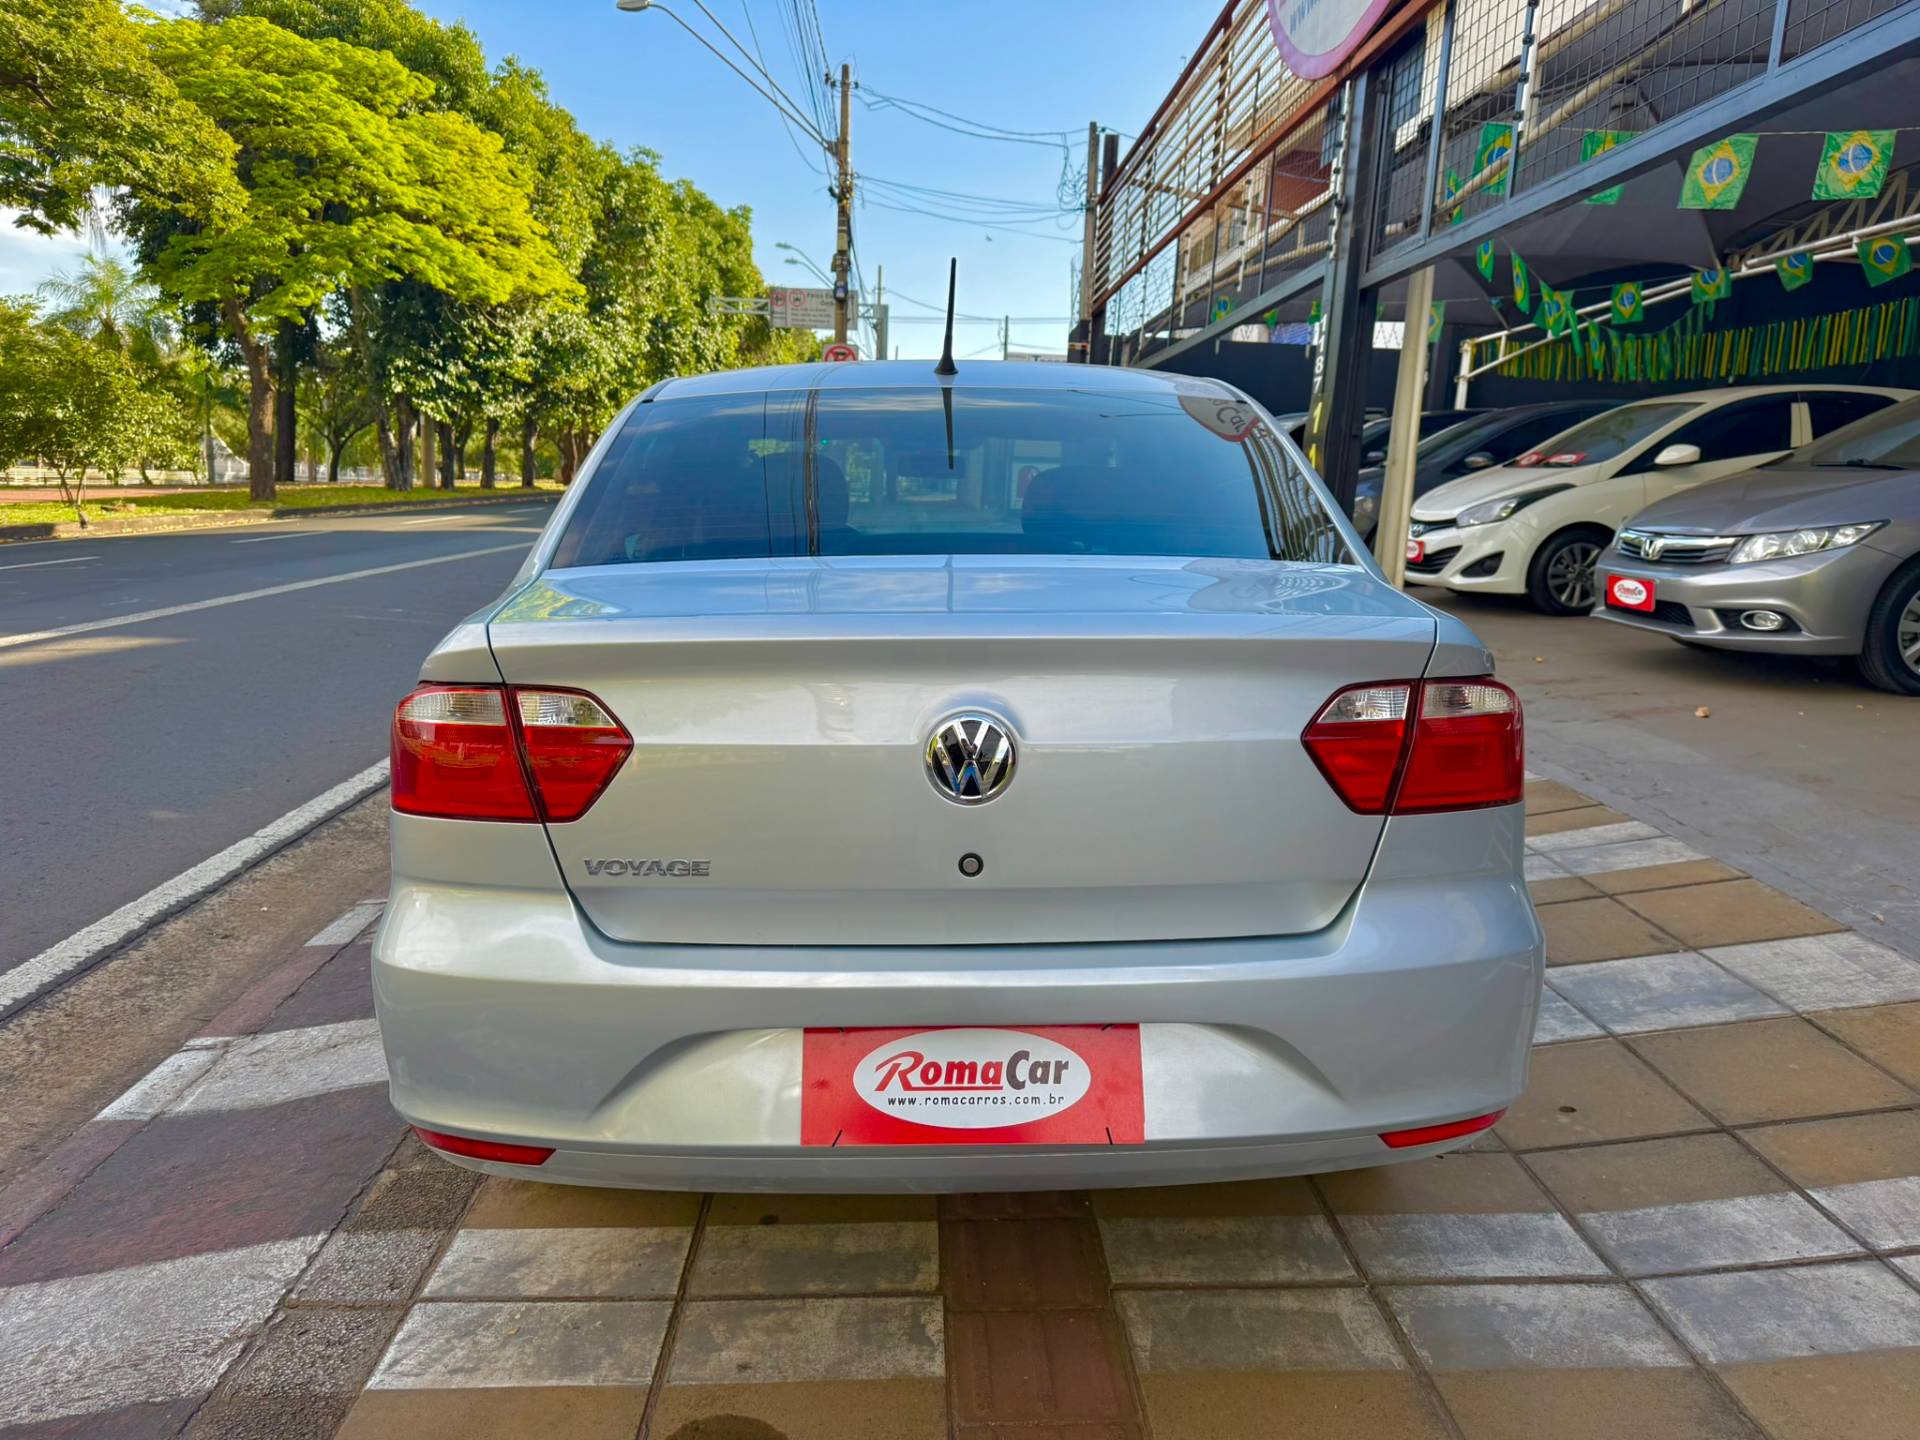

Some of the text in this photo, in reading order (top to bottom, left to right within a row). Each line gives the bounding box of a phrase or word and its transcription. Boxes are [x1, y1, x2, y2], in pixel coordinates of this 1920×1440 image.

[584, 859, 711, 876] VOYAGE
[874, 1050, 1069, 1091] RomaCar
[887, 1093, 1064, 1106] www.romacarros.com.br
